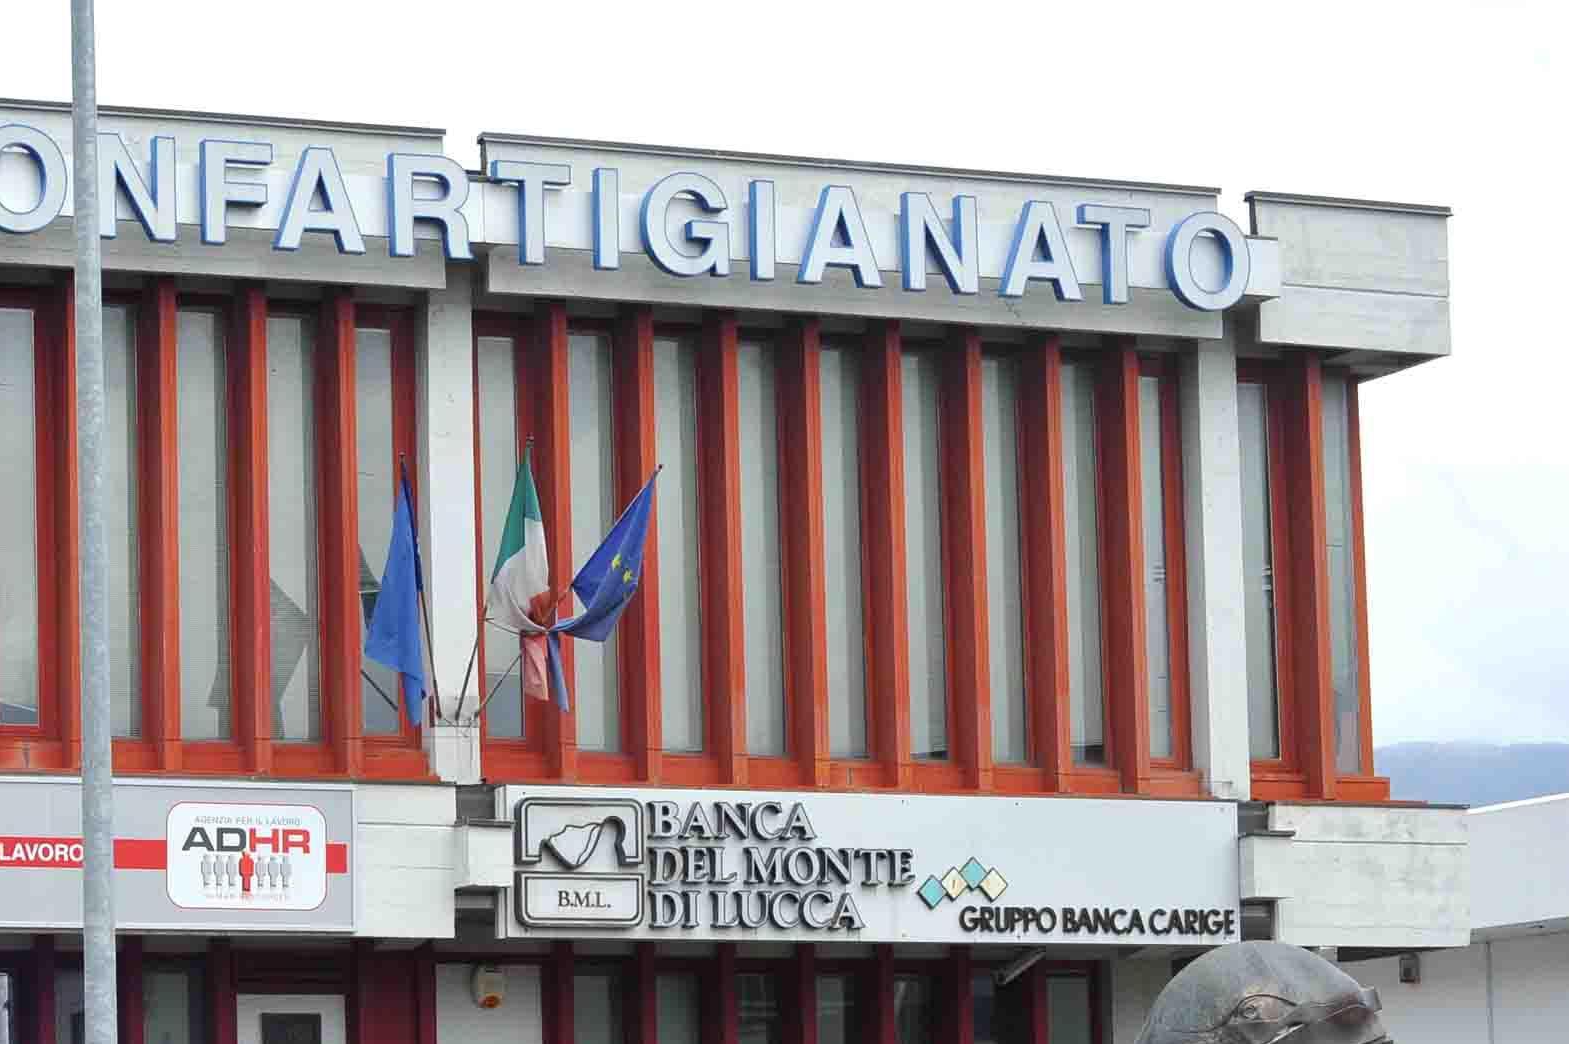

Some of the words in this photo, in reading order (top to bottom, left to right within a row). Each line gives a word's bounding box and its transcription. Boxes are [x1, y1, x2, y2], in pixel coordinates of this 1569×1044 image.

[647, 800, 817, 841] BANCA
[181, 826, 311, 855] ADHR
[647, 846, 737, 886] DEL
[742, 848, 916, 887] MONTE
[557, 889, 612, 909] B.M.L.
[647, 890, 700, 930] DI
[710, 891, 866, 930] LUCCA
[958, 905, 1058, 935] GRUPPO
[1061, 907, 1146, 936] BANCA
[1148, 907, 1236, 937] CARIGE
